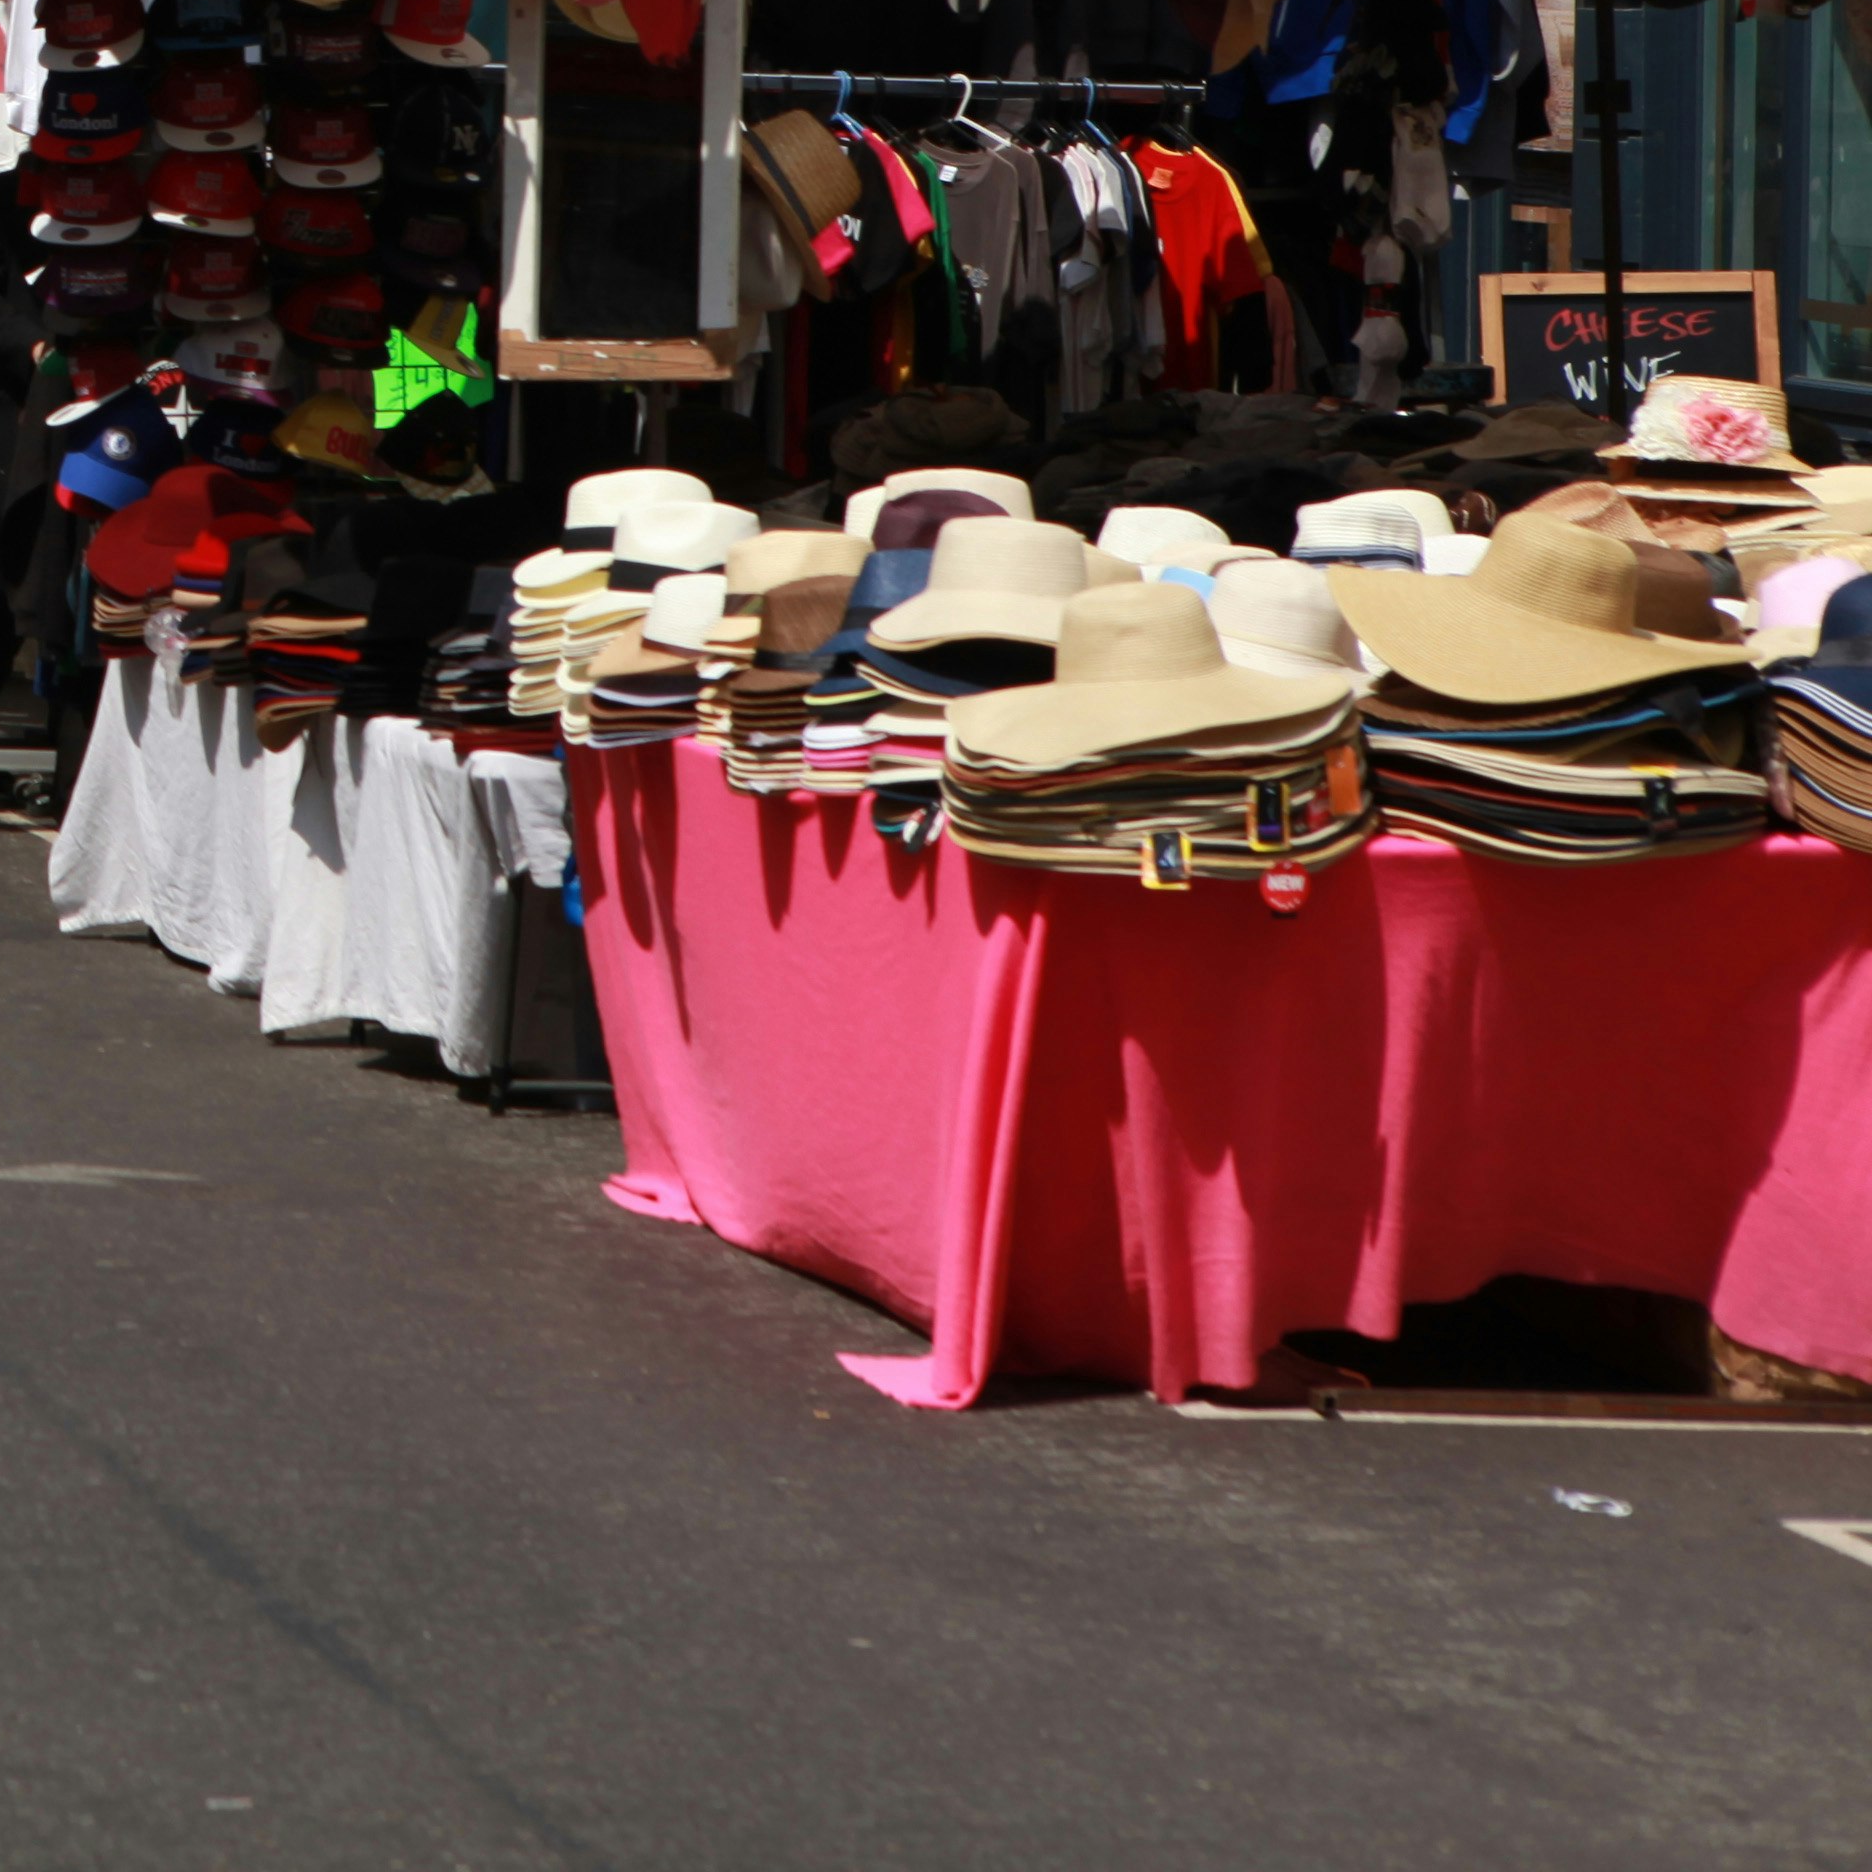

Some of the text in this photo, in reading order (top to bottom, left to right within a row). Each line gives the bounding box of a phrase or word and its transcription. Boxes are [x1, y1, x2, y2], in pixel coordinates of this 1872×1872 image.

[57, 91, 68, 111] I
[1544, 308, 1718, 351] CHESE
[1266, 874, 1305, 892] NEW
